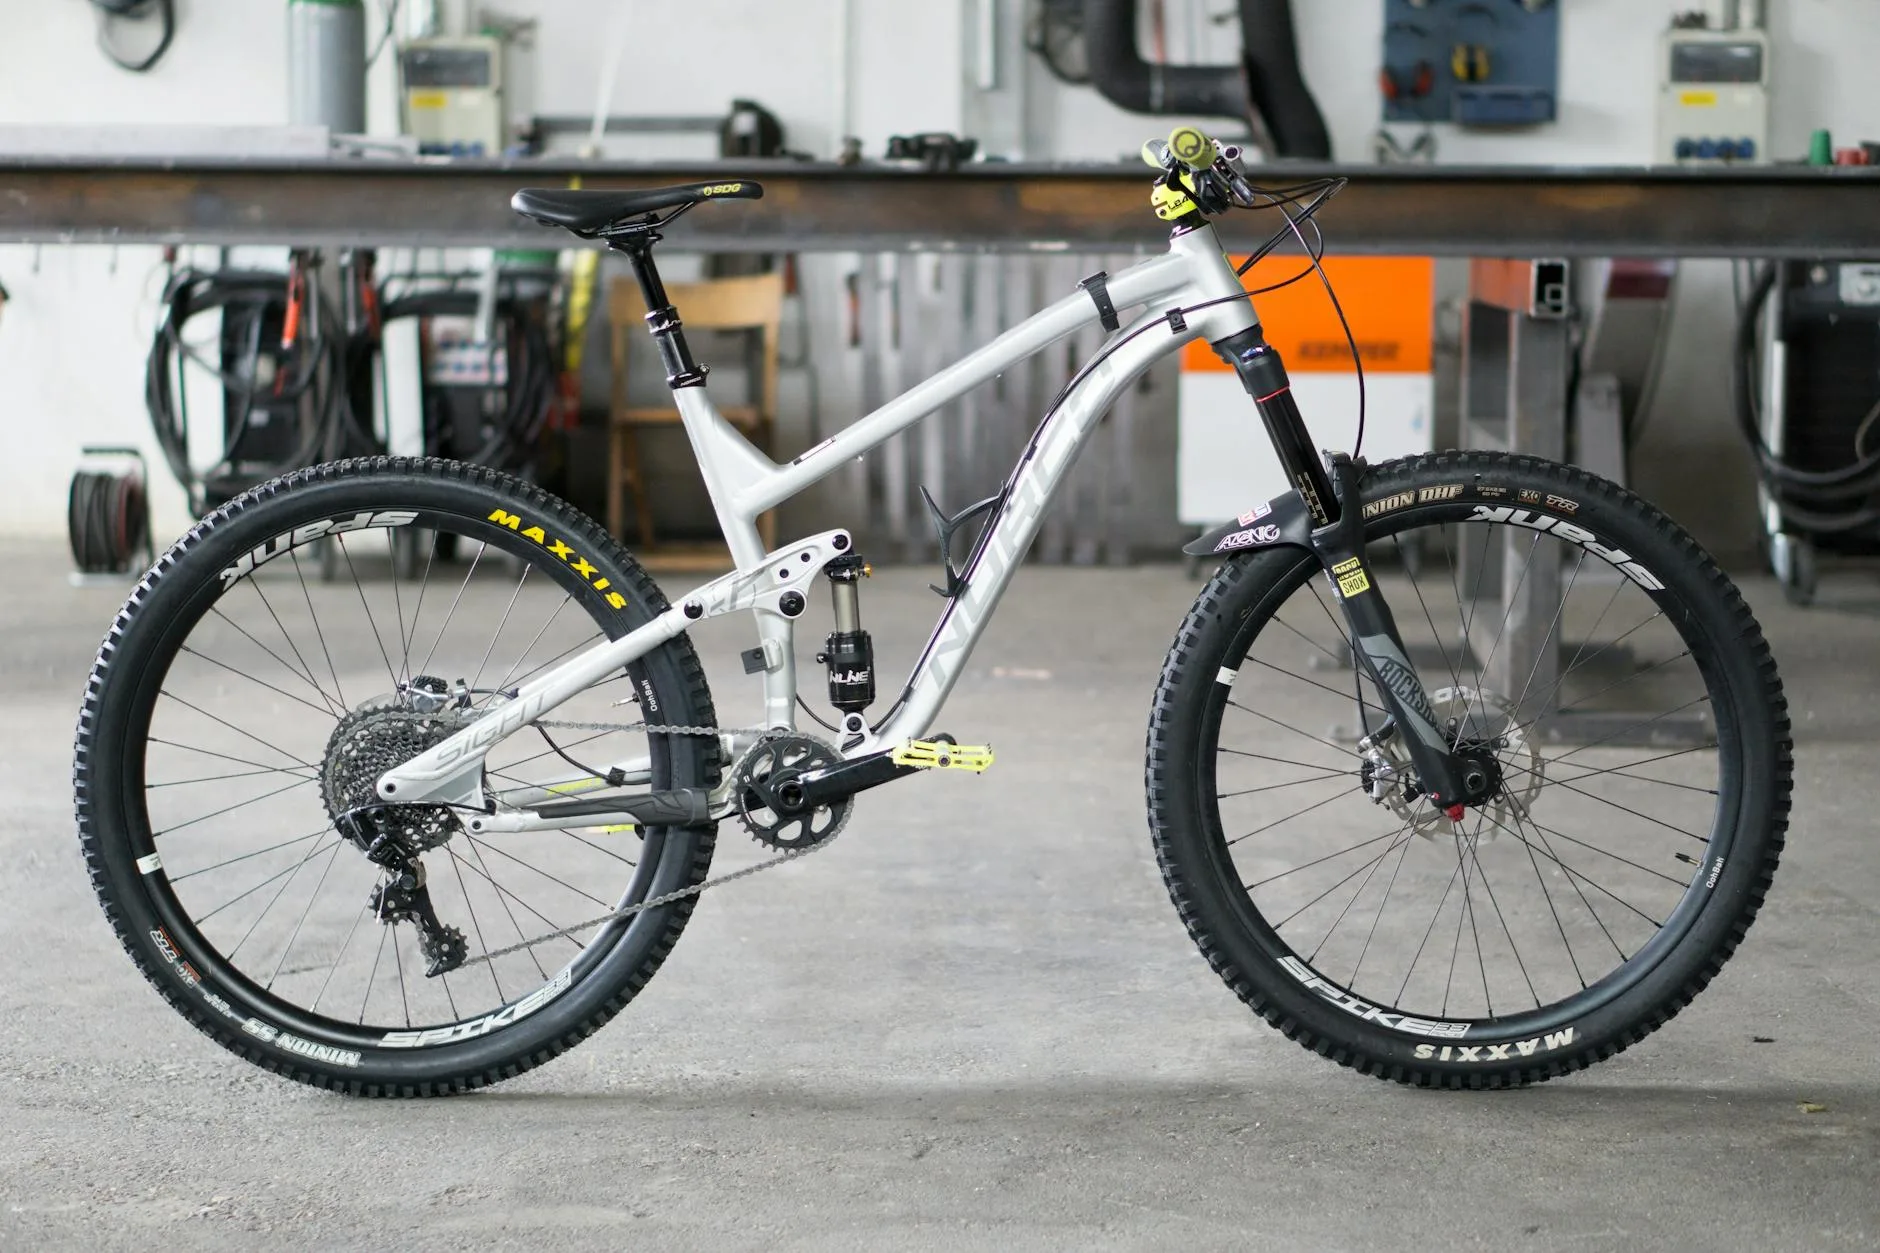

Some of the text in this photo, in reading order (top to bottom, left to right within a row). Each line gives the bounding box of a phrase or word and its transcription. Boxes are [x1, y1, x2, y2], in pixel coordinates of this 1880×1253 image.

[713, 183, 741, 194] SDG
[1362, 484, 1464, 518] INION DHF
[1520, 489, 1539, 500] EXO
[1546, 494, 1579, 511] TR
[1213, 524, 1280, 552] AZONIC
[487, 508, 627, 610] MAXXIS
[1342, 576, 1366, 594] SHOX
[435, 685, 556, 771] SIGHT
[149, 930, 178, 963] TR
[1276, 956, 1434, 1035] SPIKE
[377, 988, 546, 1048] SPIKE
[275, 1032, 362, 1068] MINION
[1413, 1027, 1574, 1062] MAXXIS
